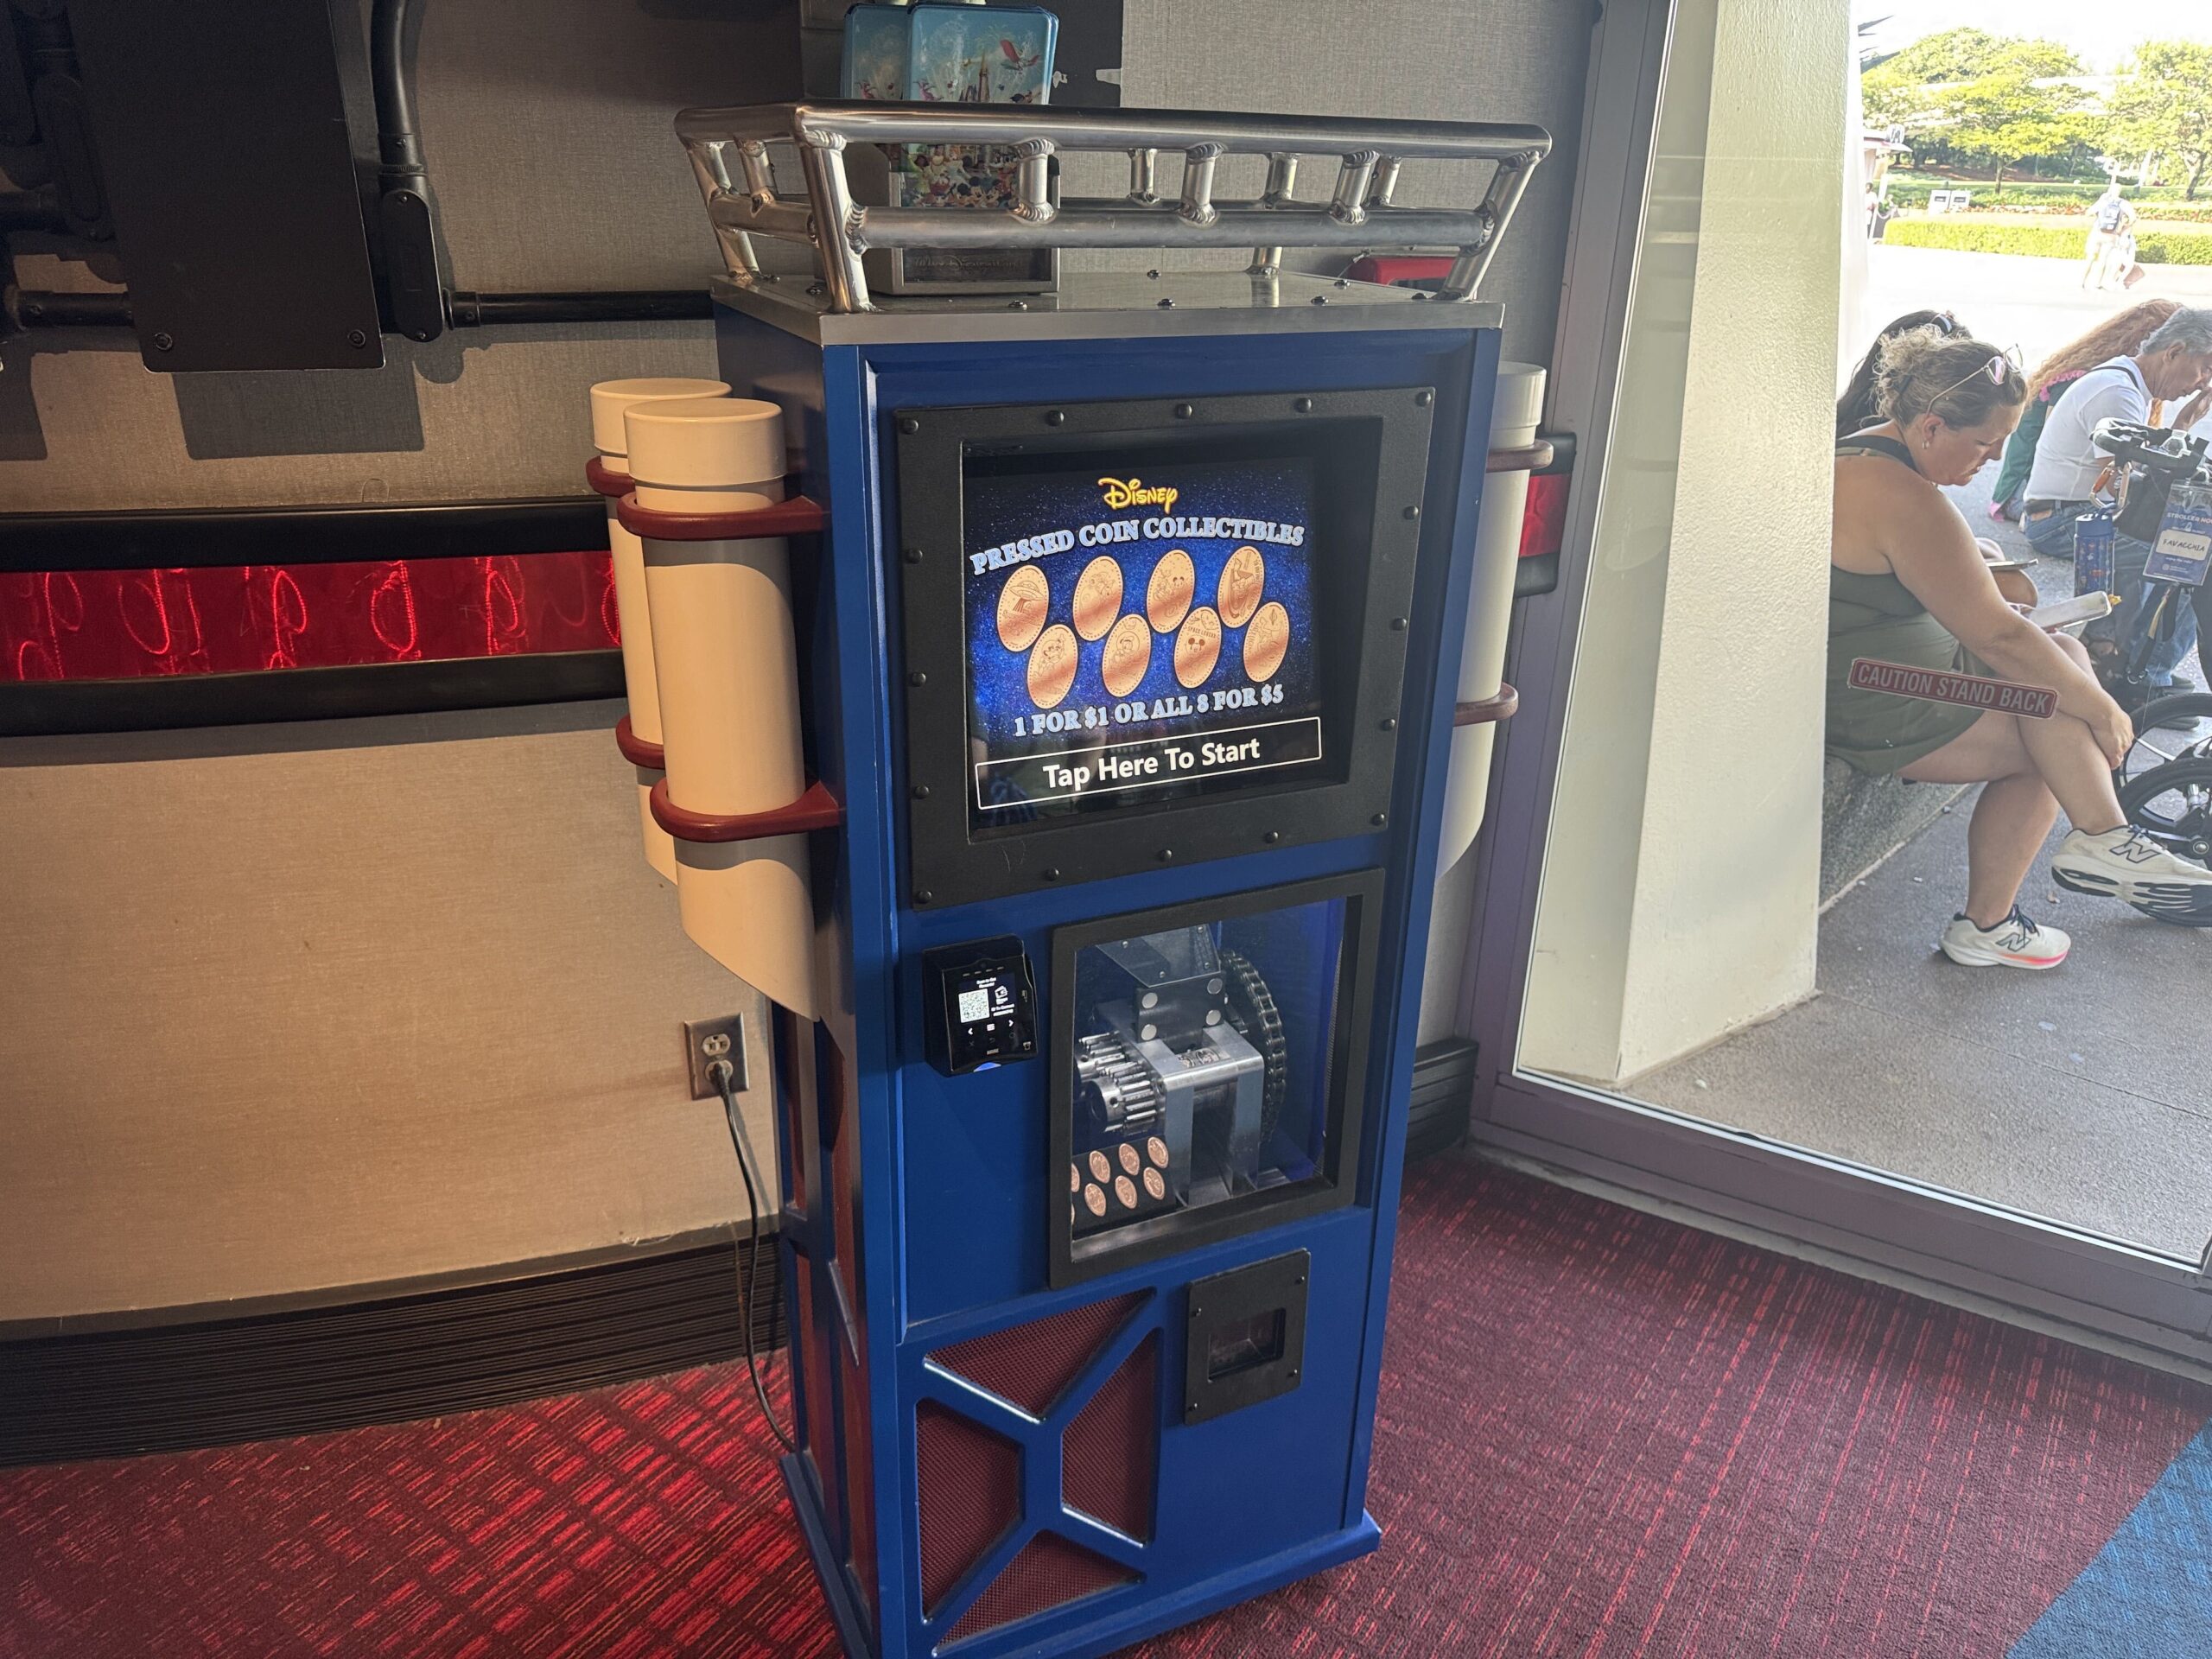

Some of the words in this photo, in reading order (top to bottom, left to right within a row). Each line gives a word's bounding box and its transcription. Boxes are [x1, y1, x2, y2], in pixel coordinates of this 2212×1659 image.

[2167, 512, 2199, 523] STROLLER
[969, 530, 1075, 575] PRESSED
[1079, 519, 1141, 547] COIN
[1143, 517, 1306, 546] COLLECTIBLES
[1014, 716, 1027, 737] 1
[1032, 709, 1082, 734] FOR
[1084, 706, 1109, 729] $1
[1114, 701, 1148, 723] OR
[1151, 696, 1193, 719] ALL
[1213, 687, 1259, 711] FOR
[1261, 683, 1284, 706] $5
[1857, 664, 1933, 694] CAUTION
[1936, 677, 1995, 705] STAND
[1999, 688, 2050, 714] BACK
[1042, 764, 1090, 791] Tap
[1098, 756, 1159, 781] Here
[1165, 747, 1194, 771] To
[1201, 738, 1260, 766] Start
